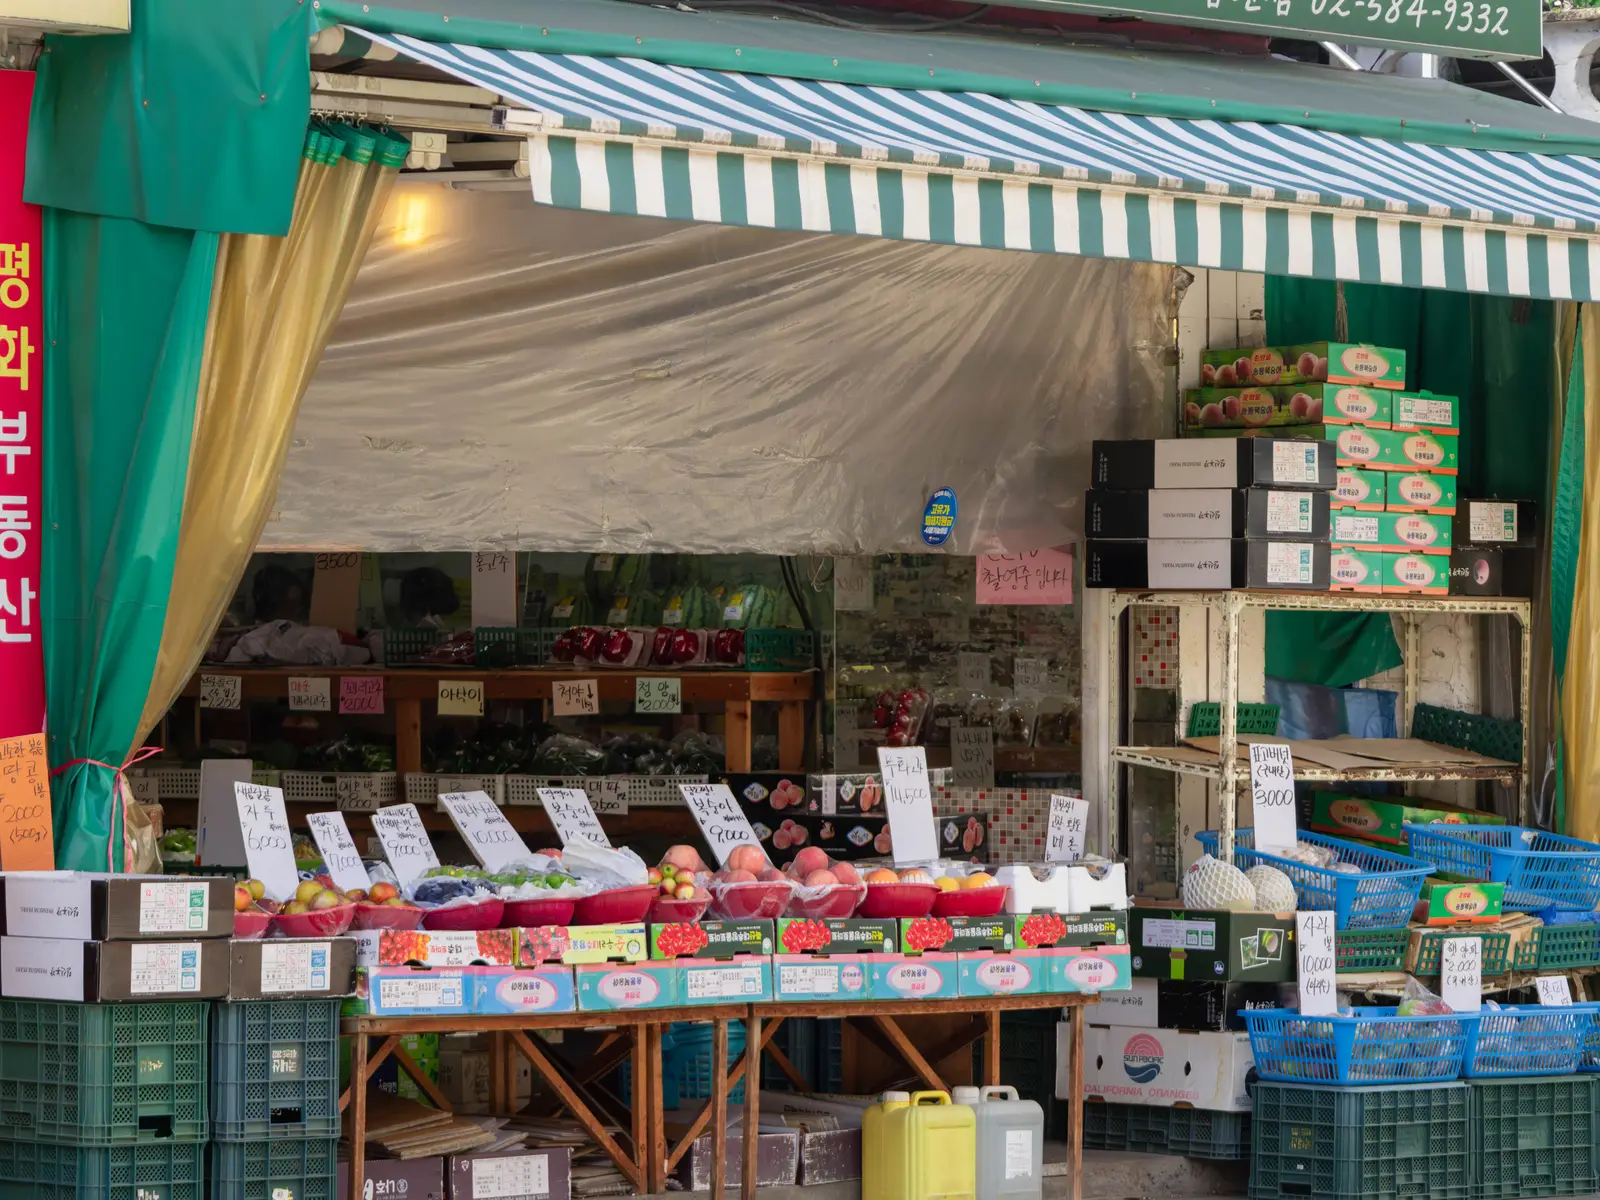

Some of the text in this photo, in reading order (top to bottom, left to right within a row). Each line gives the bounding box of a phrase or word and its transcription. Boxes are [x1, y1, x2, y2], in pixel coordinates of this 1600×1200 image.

[1310, 0, 1510, 36] 02-584-9332
[244, 803, 275, 821] 자두
[248, 827, 287, 851] 6,000
[709, 825, 750, 843] 9,000
[1303, 915, 1330, 938] 사과
[1123, 1054, 1164, 1064] SUN PACIFIC
[1084, 1083, 1200, 1100] CALIFORNIA ORANGES
